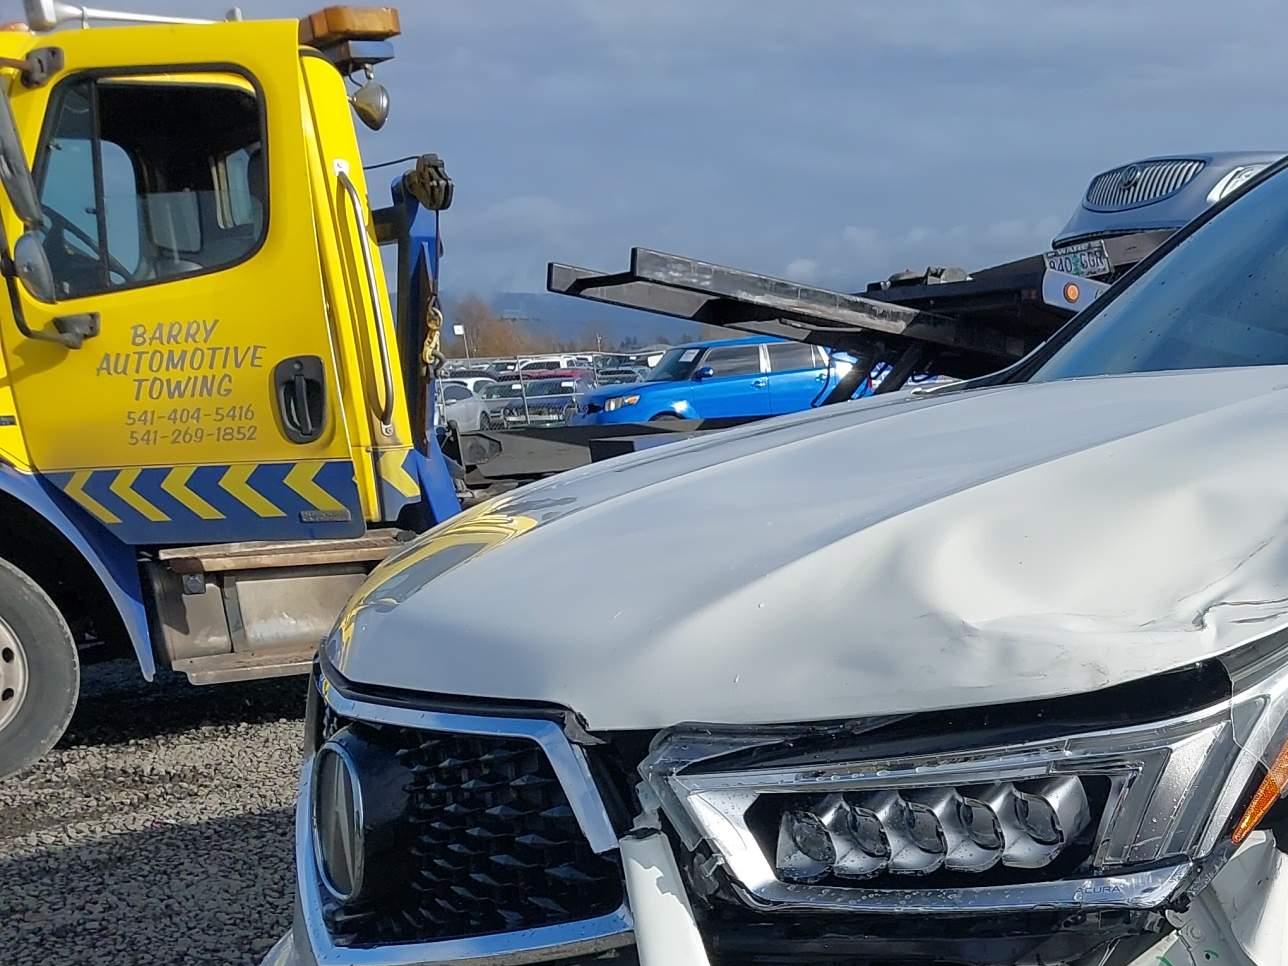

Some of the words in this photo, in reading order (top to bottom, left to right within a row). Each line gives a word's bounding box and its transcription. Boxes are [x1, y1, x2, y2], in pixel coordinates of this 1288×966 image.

[131, 320, 219, 346] BARRY
[97, 345, 266, 376] AUTOMOTIVE
[133, 374, 233, 401] TOWING
[126, 405, 255, 426] 541-404-5416
[129, 426, 257, 446] 541-269-1852
[1075, 885, 1122, 896] ACURA
